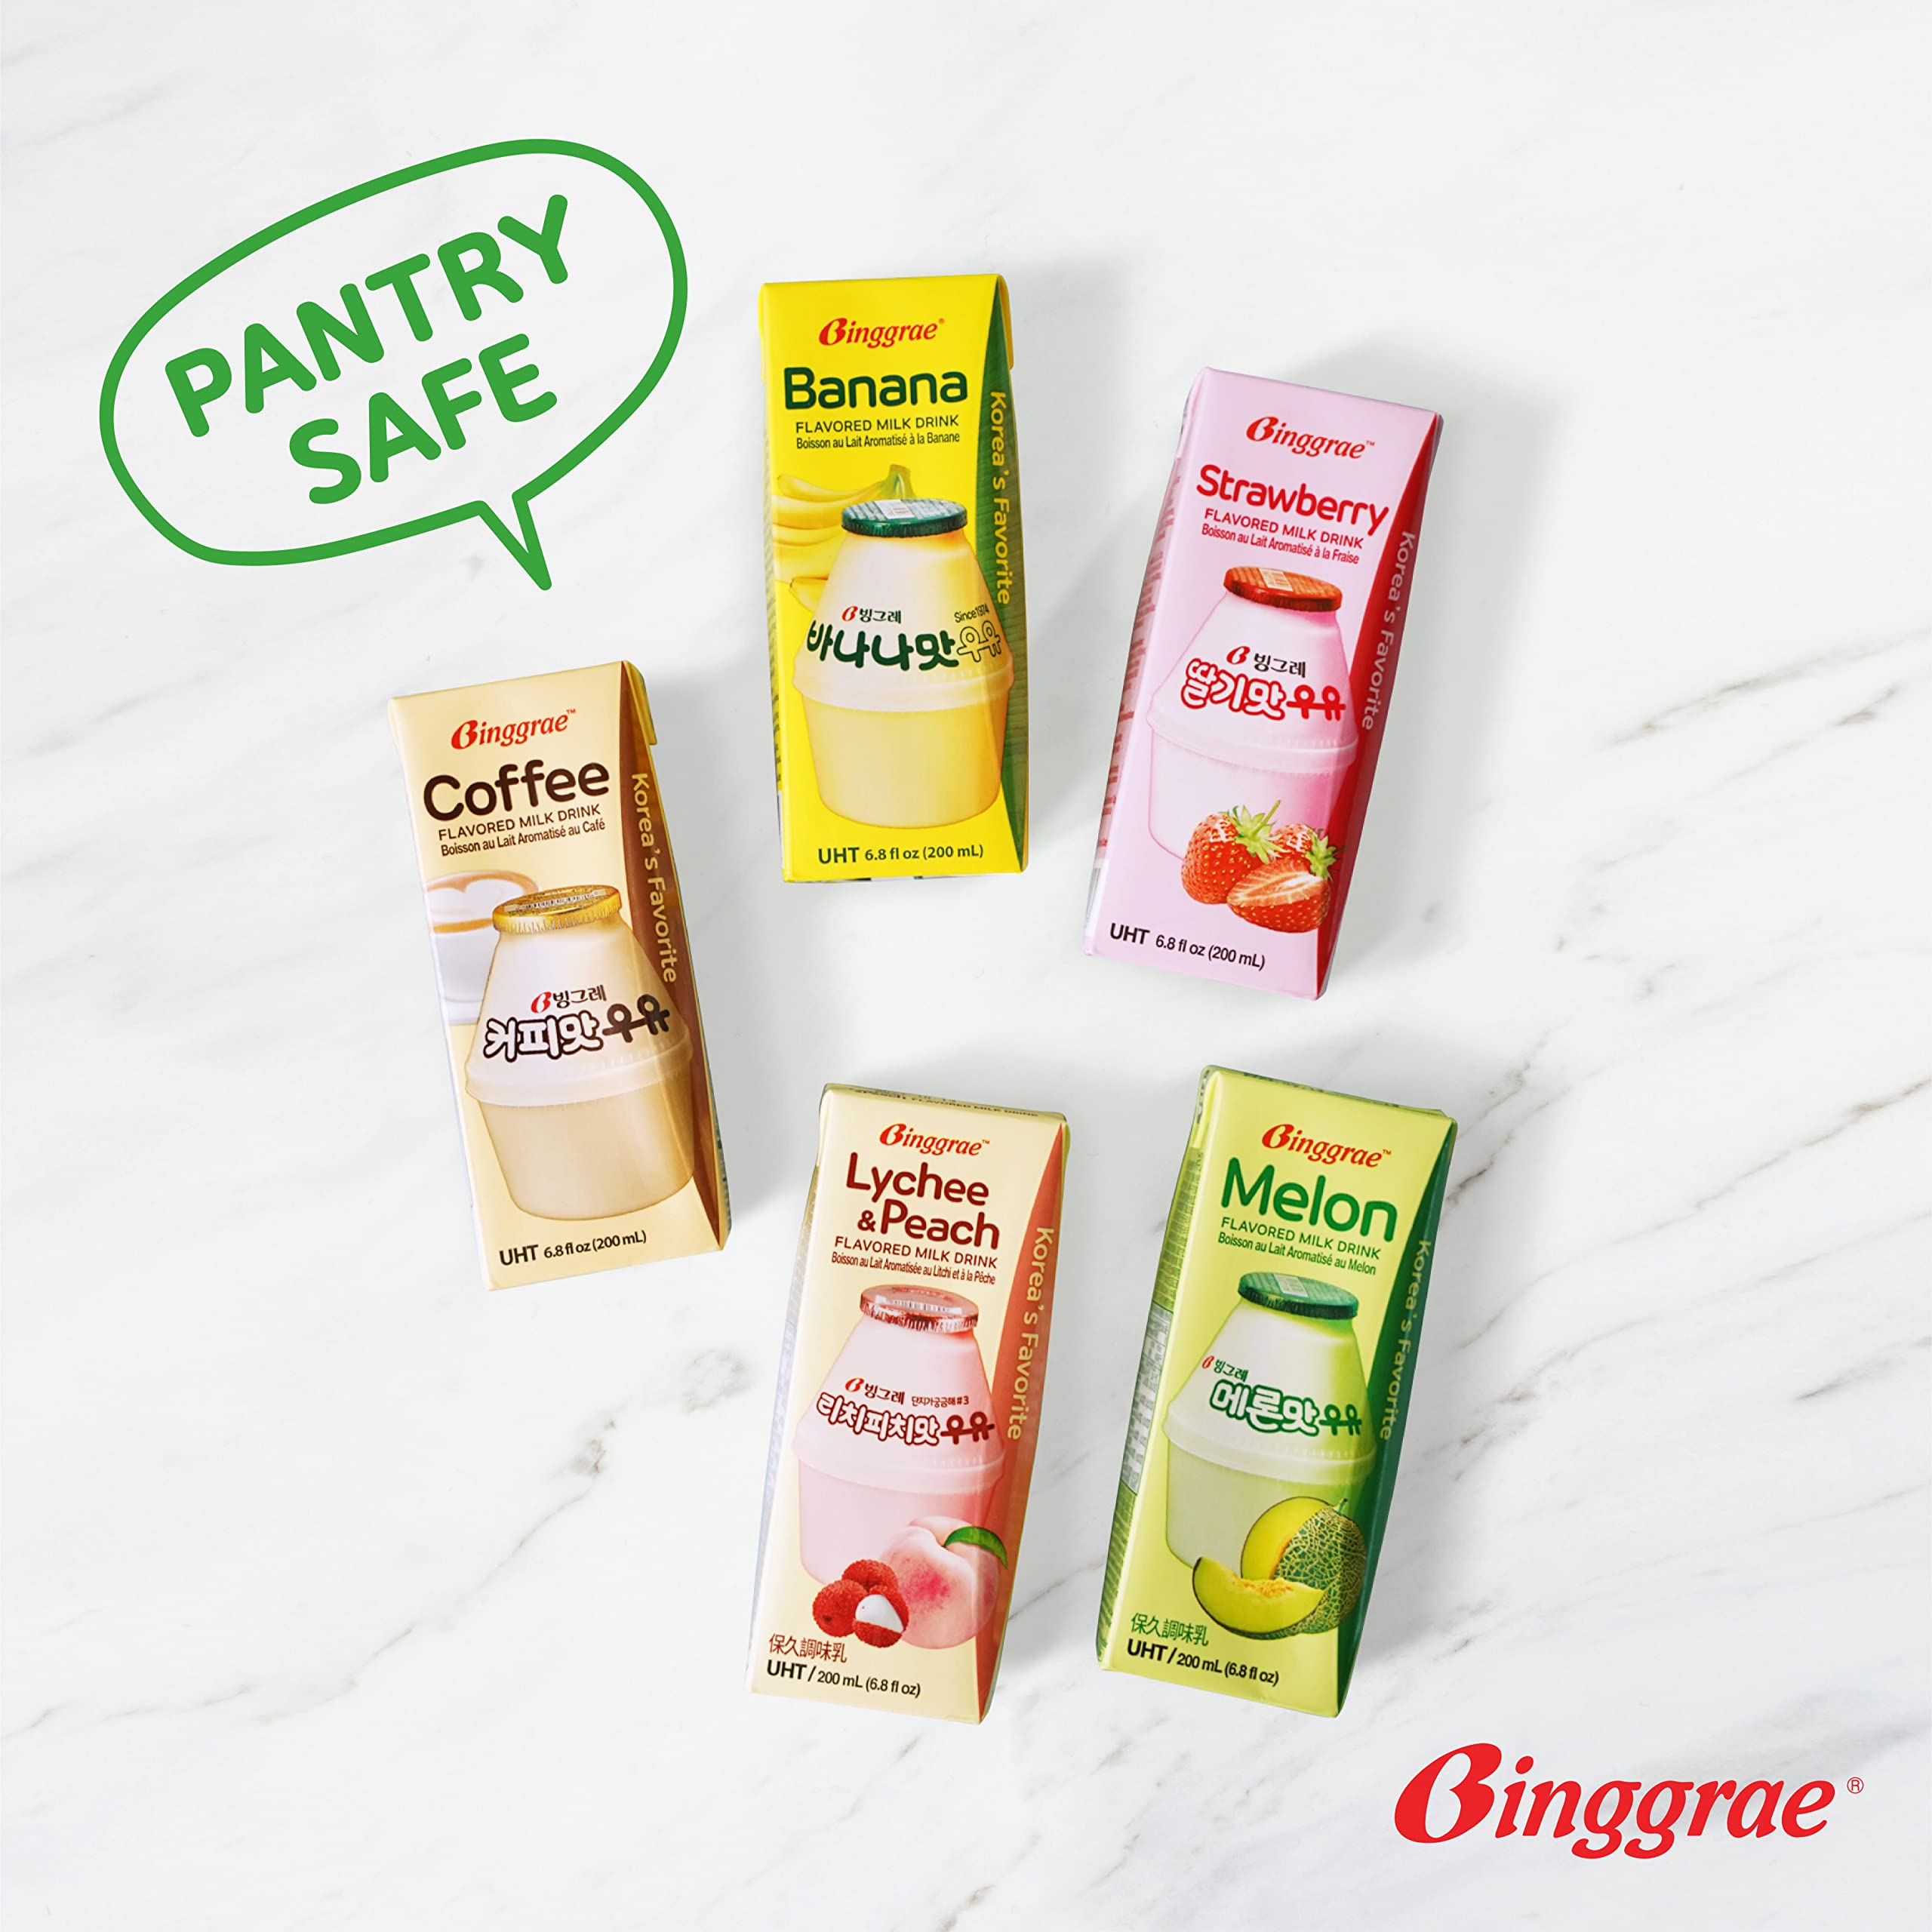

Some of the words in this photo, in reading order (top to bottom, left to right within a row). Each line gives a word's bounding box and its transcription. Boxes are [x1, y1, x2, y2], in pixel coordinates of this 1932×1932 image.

[783, 367, 968, 410] Banana
[795, 420, 872, 433] FLAVORED
[877, 417, 911, 430] MILK
[916, 414, 959, 429] DRINK
[796, 437, 830, 449] Boisson
[833, 438, 844, 448] au
[845, 435, 862, 448] Lait
[864, 433, 907, 447] Aromatisé
[909, 433, 915, 445] à
[917, 432, 924, 445] la
[927, 432, 960, 444] Banane
[1195, 464, 1389, 536] Strawberry
[1201, 523, 1236, 541] Boisson
[1237, 533, 1249, 543] au
[1251, 534, 1267, 548] Lait
[1268, 537, 1313, 557] Aromatisé
[1314, 546, 1320, 558] à
[1322, 548, 1330, 559] la
[1331, 549, 1359, 564] Fraise
[1204, 507, 1279, 534] FLAVORED
[1282, 524, 1318, 541] MILK
[1320, 531, 1364, 549] DRINK
[994, 497, 1013, 604] Favorite
[859, 608, 902, 624] 빙그레
[1253, 653, 1306, 678] 빙그레
[1361, 629, 1395, 731] Favorite
[423, 758, 610, 822] Coffee
[438, 818, 515, 841] FLAVORED
[519, 812, 554, 829] MILK
[558, 804, 601, 822] DRINK
[441, 841, 481, 857] Boisson
[483, 839, 495, 851] au
[497, 835, 516, 848] Lait
[518, 826, 566, 845] Aromatisé
[568, 825, 580, 836] au
[583, 817, 606, 833] Café
[818, 847, 860, 864] UHT
[865, 848, 887, 861] 6.8
[890, 847, 899, 860] fl
[903, 849, 919, 860] oz
[922, 845, 954, 860] (200
[957, 844, 983, 858] mL)
[648, 876, 678, 983] Favorite
[1110, 922, 1150, 945] UHT
[1155, 934, 1176, 950] 6.8
[1178, 939, 1188, 952] fl
[1189, 943, 1206, 956] oz
[1208, 945, 1236, 962] (200
[1238, 954, 1266, 971] mL)
[552, 984, 607, 1009] 빙그레
[846, 1152, 989, 1205] Lychee
[1221, 1157, 1398, 1242] Melon
[499, 1244, 539, 1266] UHT
[543, 1244, 564, 1258] 6.8
[565, 1242, 574, 1255] fl
[576, 1242, 591, 1253] oz
[592, 1235, 620, 1252] (200
[622, 1229, 647, 1245] mL)
[835, 1236, 911, 1257] FLAVORED
[915, 1247, 950, 1263] MILK
[955, 1252, 998, 1269] DRINK
[1218, 1232, 1253, 1250] Boisson
[1255, 1241, 1266, 1252] au
[1269, 1242, 1285, 1257] Lait
[1287, 1245, 1332, 1266] Aromatisé
[1334, 1257, 1346, 1269] au
[1348, 1259, 1377, 1275] Melon
[1221, 1217, 1295, 1241] FLAVORED
[1299, 1232, 1334, 1250] MILK
[1337, 1241, 1381, 1260] DRINK
[832, 1251, 858, 1266] Boisson
[860, 1257, 869, 1268] au
[869, 1256, 883, 1269] Lait
[884, 1260, 922, 1275] Aromatisée
[923, 1266, 932, 1276] au
[933, 1266, 951, 1278] Litchi
[952, 1269, 960, 1280] et
[967, 1271, 973, 1281] la
[974, 1270, 995, 1284] Pêche
[1008, 1333, 1039, 1440] Favorite
[1214, 1359, 1249, 1383] 빙그레
[1379, 1338, 1411, 1440] Favorite
[864, 1383, 905, 1405] 빙그레
[768, 1633, 848, 1663] 保久調味乳
[1131, 1613, 1209, 1647] 保久調味乳
[767, 1660, 808, 1680] UHT
[817, 1671, 840, 1685] 200
[842, 1675, 863, 1688] mL
[866, 1676, 888, 1692] (6.8
[891, 1680, 899, 1693] fl
[901, 1683, 921, 1698] oz)
[1127, 1638, 1168, 1662] UHT
[1177, 1653, 1200, 1669] 200
[1201, 1660, 1223, 1674] mL
[1225, 1661, 1247, 1678] (6.8
[1249, 1666, 1258, 1680] fl
[1260, 1671, 1279, 1687] oz)
